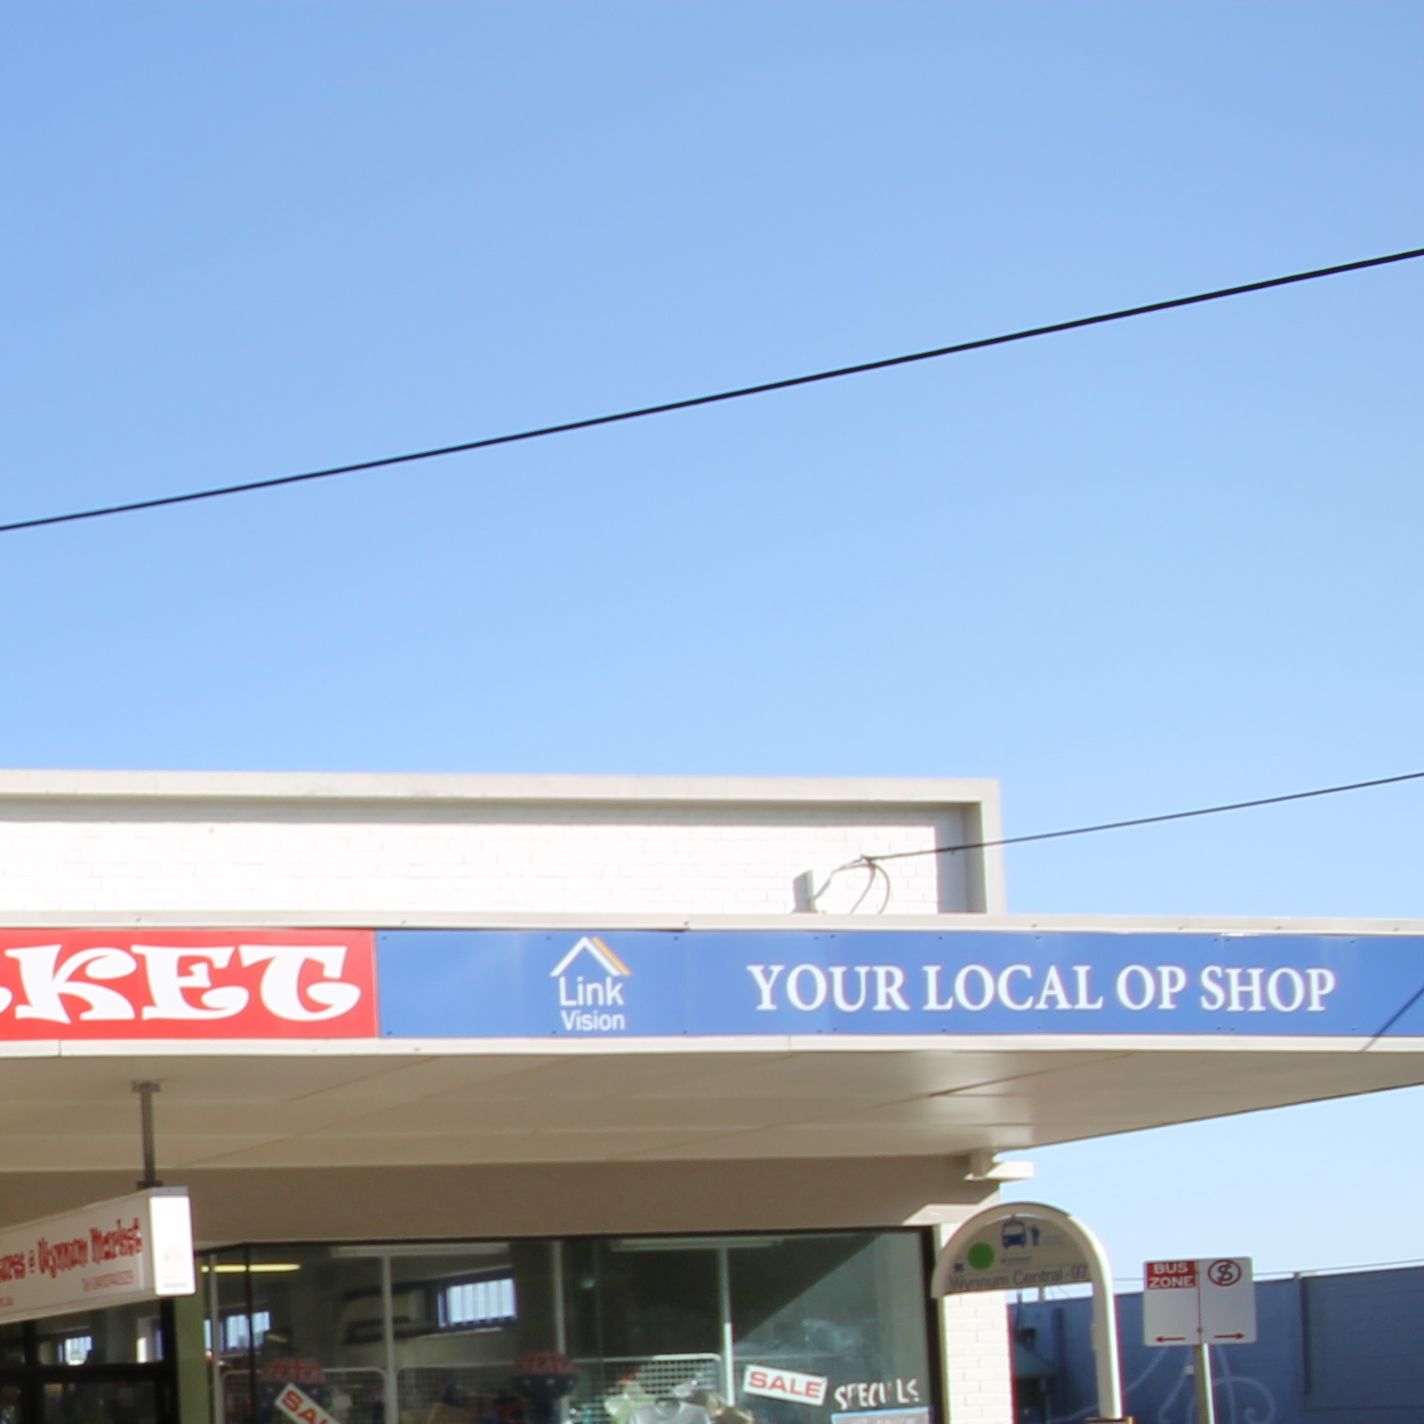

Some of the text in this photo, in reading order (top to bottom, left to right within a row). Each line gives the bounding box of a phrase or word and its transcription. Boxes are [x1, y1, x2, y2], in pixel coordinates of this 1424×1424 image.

[558, 975, 625, 1006] Link
[746, 963, 1336, 1012] YOUR LOCAL OP SHOP
[560, 1009, 627, 1031] Vision
[1012, 1266, 1063, 1285] Central
[1154, 1261, 1188, 1274] BUS
[1149, 1276, 1193, 1289] ZONE
[749, 1371, 824, 1399] SALE
[834, 1377, 921, 1412] SPECILS
